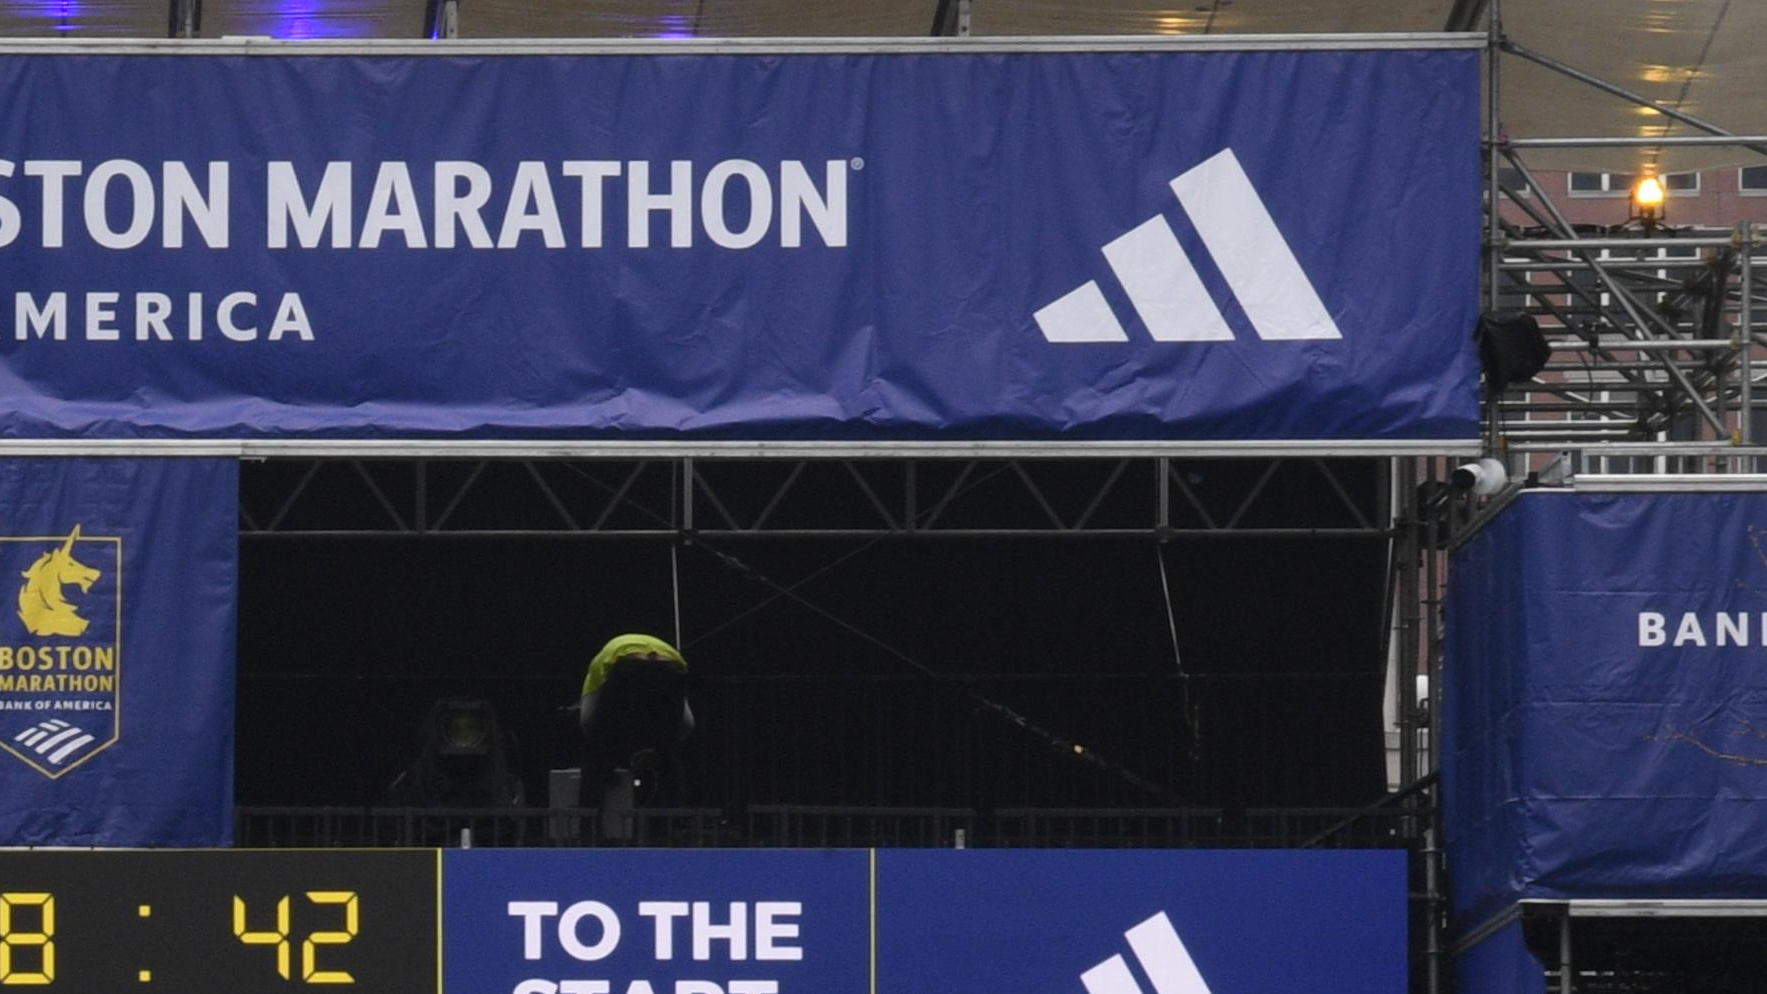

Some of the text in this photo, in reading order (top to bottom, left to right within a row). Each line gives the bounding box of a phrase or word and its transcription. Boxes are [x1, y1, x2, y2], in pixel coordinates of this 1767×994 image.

[1638, 612, 1767, 647] BAN
[34, 700, 50, 710] OF
[53, 700, 112, 711] AMERICA
[233, 891, 359, 984] 42
[507, 900, 803, 961] TO THE
